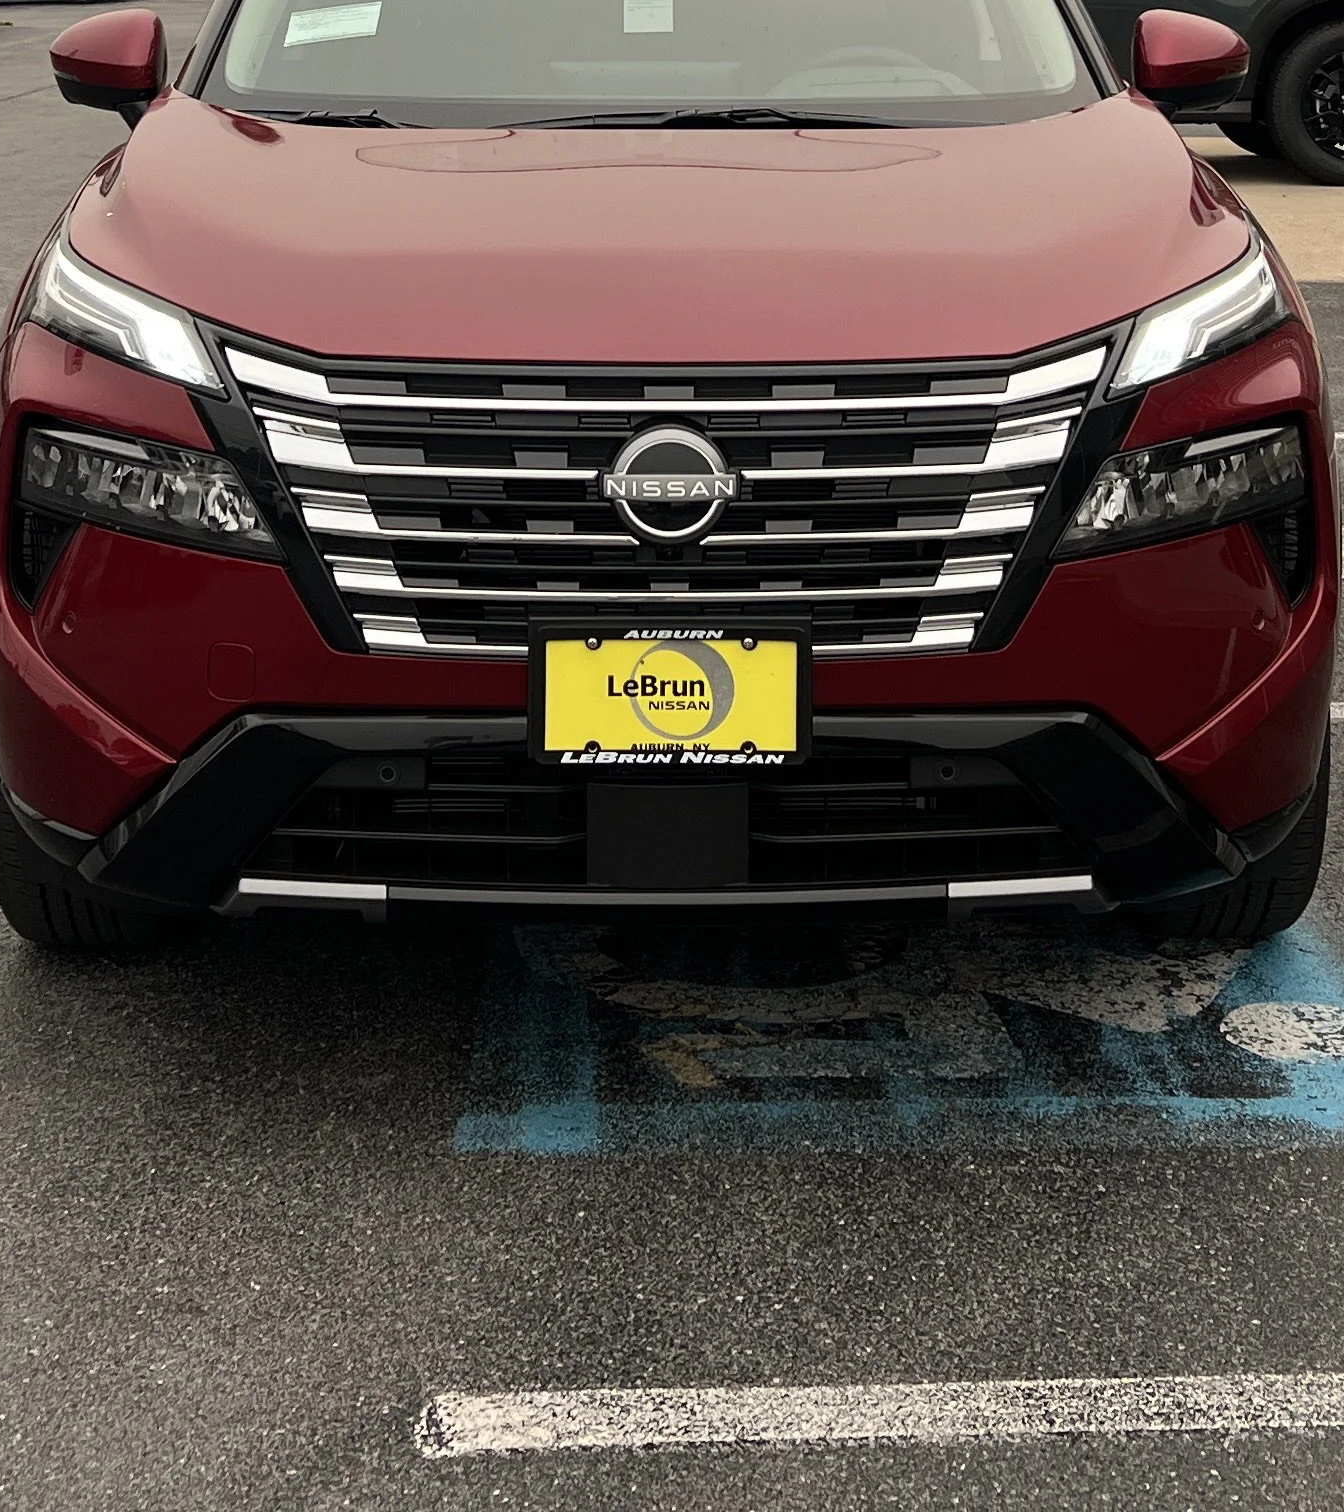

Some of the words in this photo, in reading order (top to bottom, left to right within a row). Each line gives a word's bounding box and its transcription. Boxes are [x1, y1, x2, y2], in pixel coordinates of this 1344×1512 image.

[607, 479, 734, 498] NISSAN
[623, 629, 724, 640] AUBURN
[607, 675, 705, 697] LeBrun
[648, 701, 710, 711] NISSAN
[692, 743, 711, 751] NY
